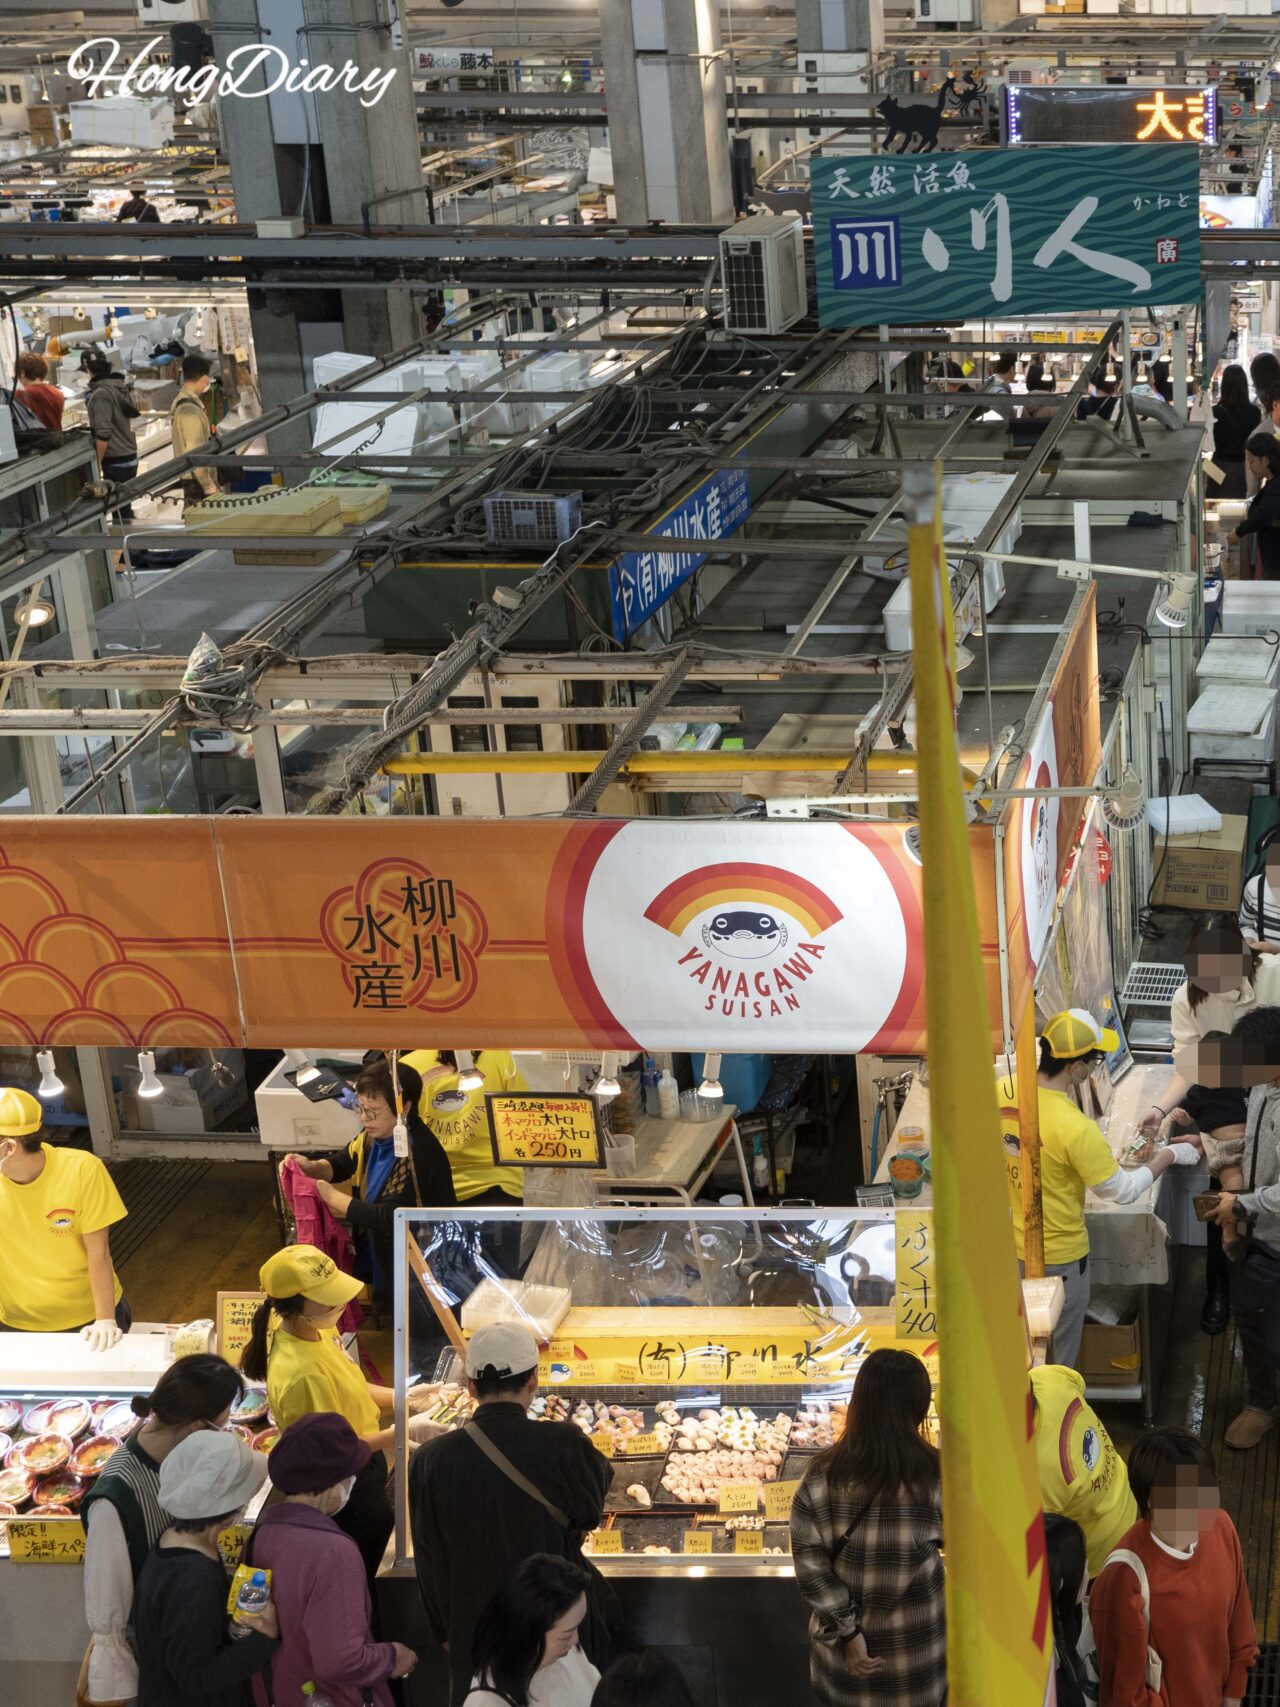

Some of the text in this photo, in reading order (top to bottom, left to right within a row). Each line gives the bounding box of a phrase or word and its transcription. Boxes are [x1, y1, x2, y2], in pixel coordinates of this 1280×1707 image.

[828, 160, 976, 199] 天然 活魚
[1133, 194, 1190, 211] かわと
[921, 192, 1152, 302] 川人
[401, 875, 461, 982] 柳川
[343, 904, 408, 1009] 水産
[677, 942, 826, 998] YANAGAWA
[704, 993, 801, 1019] SUISAN
[503, 1113, 575, 1128] 本マグロ大トロ
[10, 1523, 47, 1539] 限定!!
